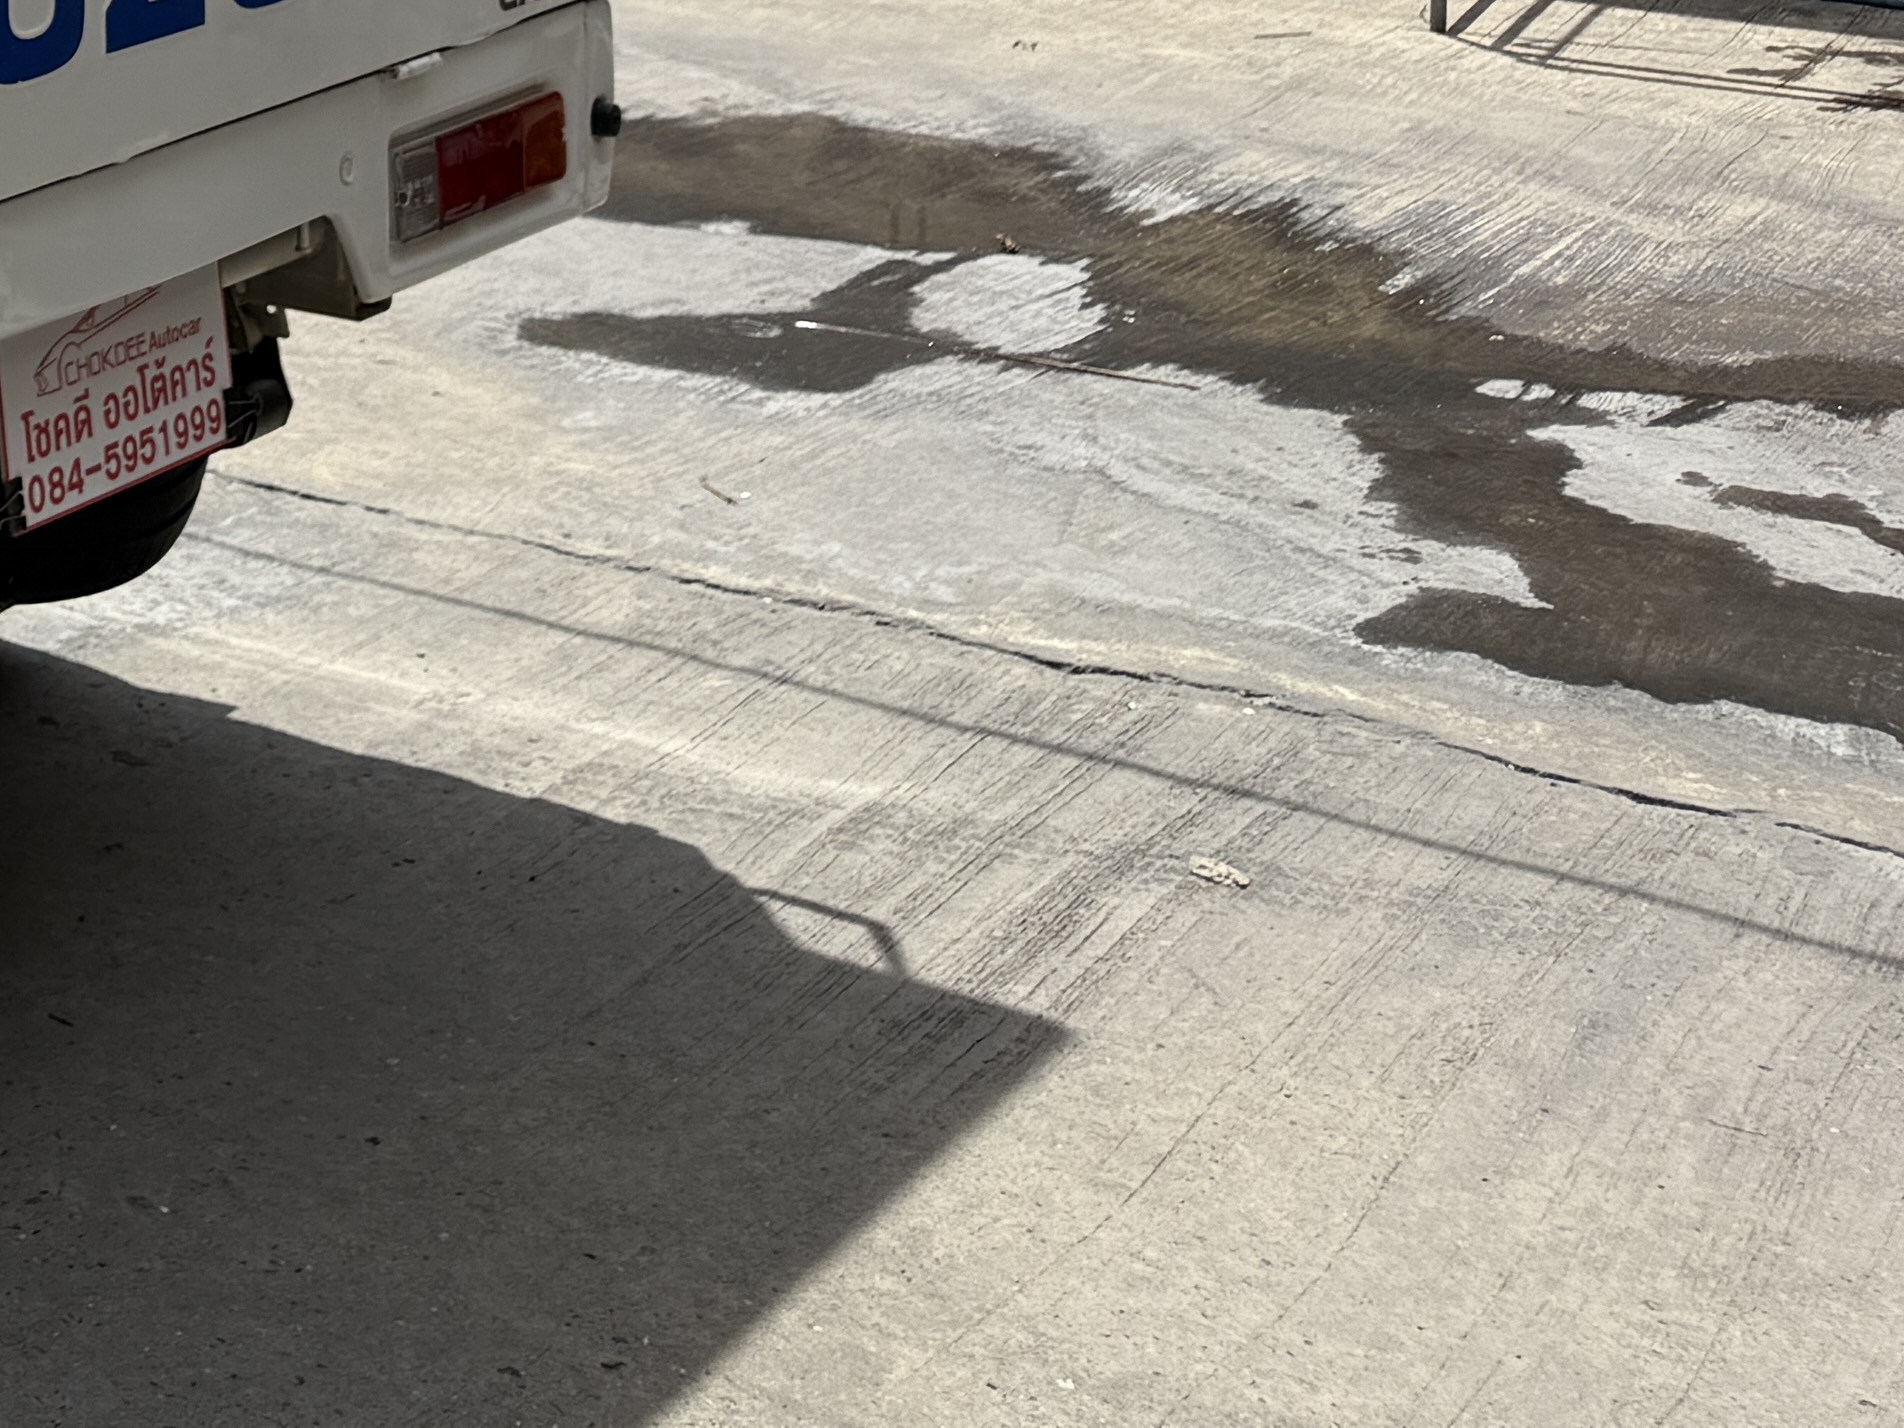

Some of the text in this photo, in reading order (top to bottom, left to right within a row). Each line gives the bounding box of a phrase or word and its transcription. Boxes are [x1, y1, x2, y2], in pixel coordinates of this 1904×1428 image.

[20, 335, 217, 464] โชคดี ออโต้คาร์
[64, 316, 202, 386] CHOKDEE Autocar
[27, 397, 222, 514] 084-5951999
